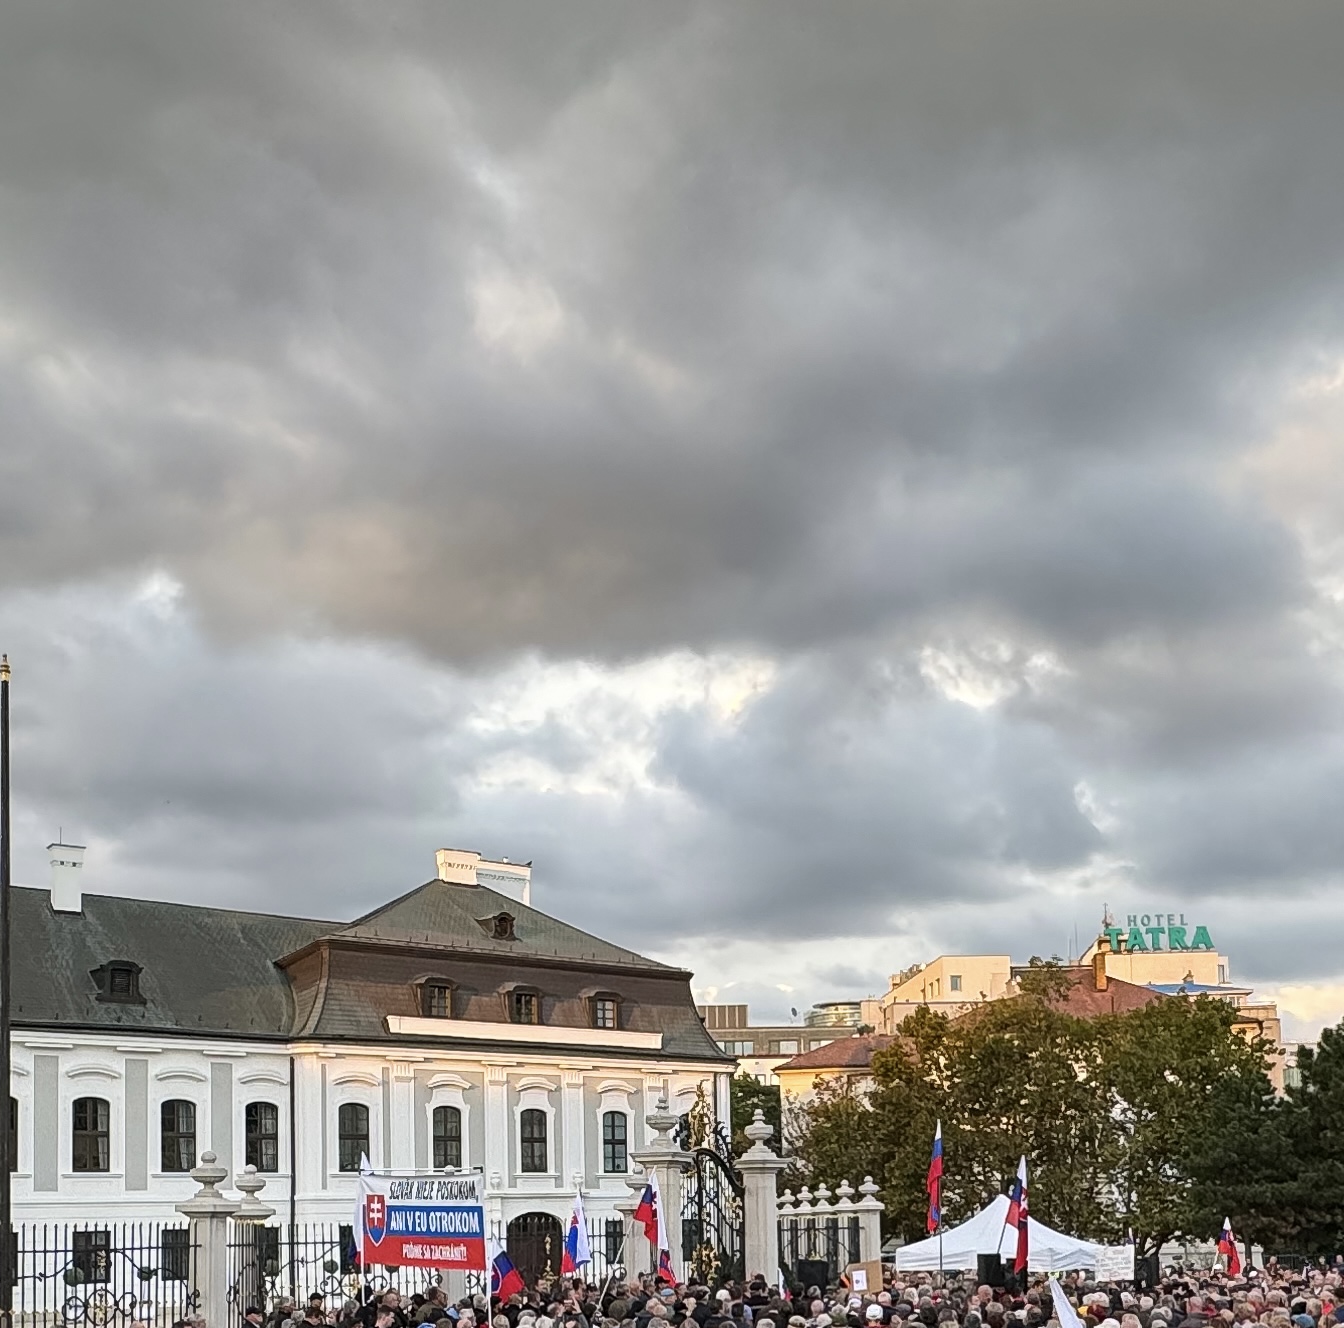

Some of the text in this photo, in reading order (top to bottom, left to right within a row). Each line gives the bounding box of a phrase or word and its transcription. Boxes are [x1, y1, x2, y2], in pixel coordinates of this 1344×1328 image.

[1127, 913, 1188, 927] HOTEL
[1104, 925, 1214, 951] TATRA
[390, 1210, 481, 1233] ANI V EU OTROKOM
